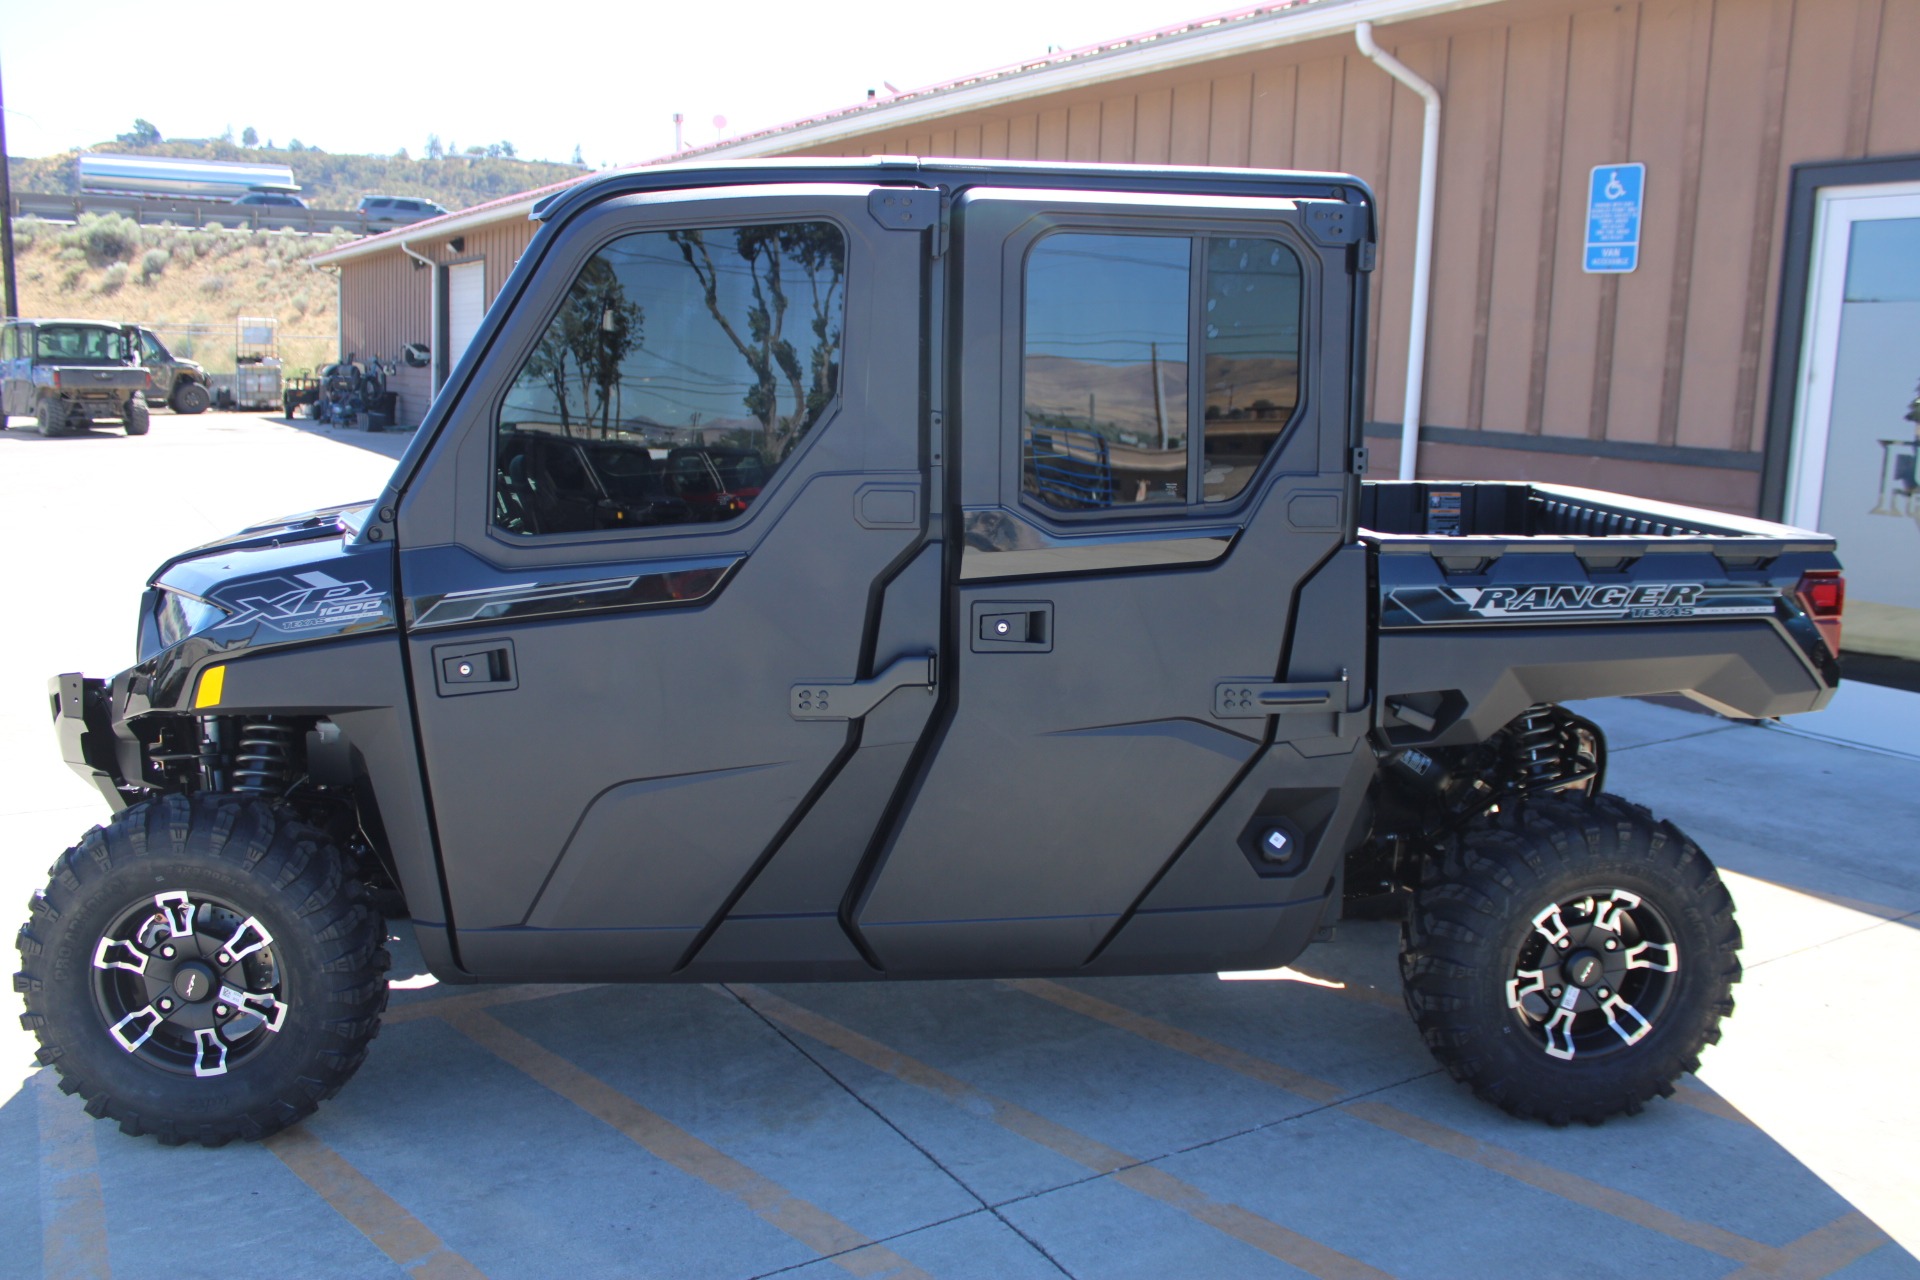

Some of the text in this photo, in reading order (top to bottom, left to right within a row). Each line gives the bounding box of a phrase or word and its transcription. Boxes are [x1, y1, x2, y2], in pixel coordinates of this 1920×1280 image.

[1601, 248, 1621, 257] VAN
[1469, 583, 1705, 611] RANGER
[212, 580, 387, 630] XP
[318, 600, 382, 617] 1000
[1631, 606, 1696, 618] TEXAS
[283, 617, 327, 630] TEXAS
